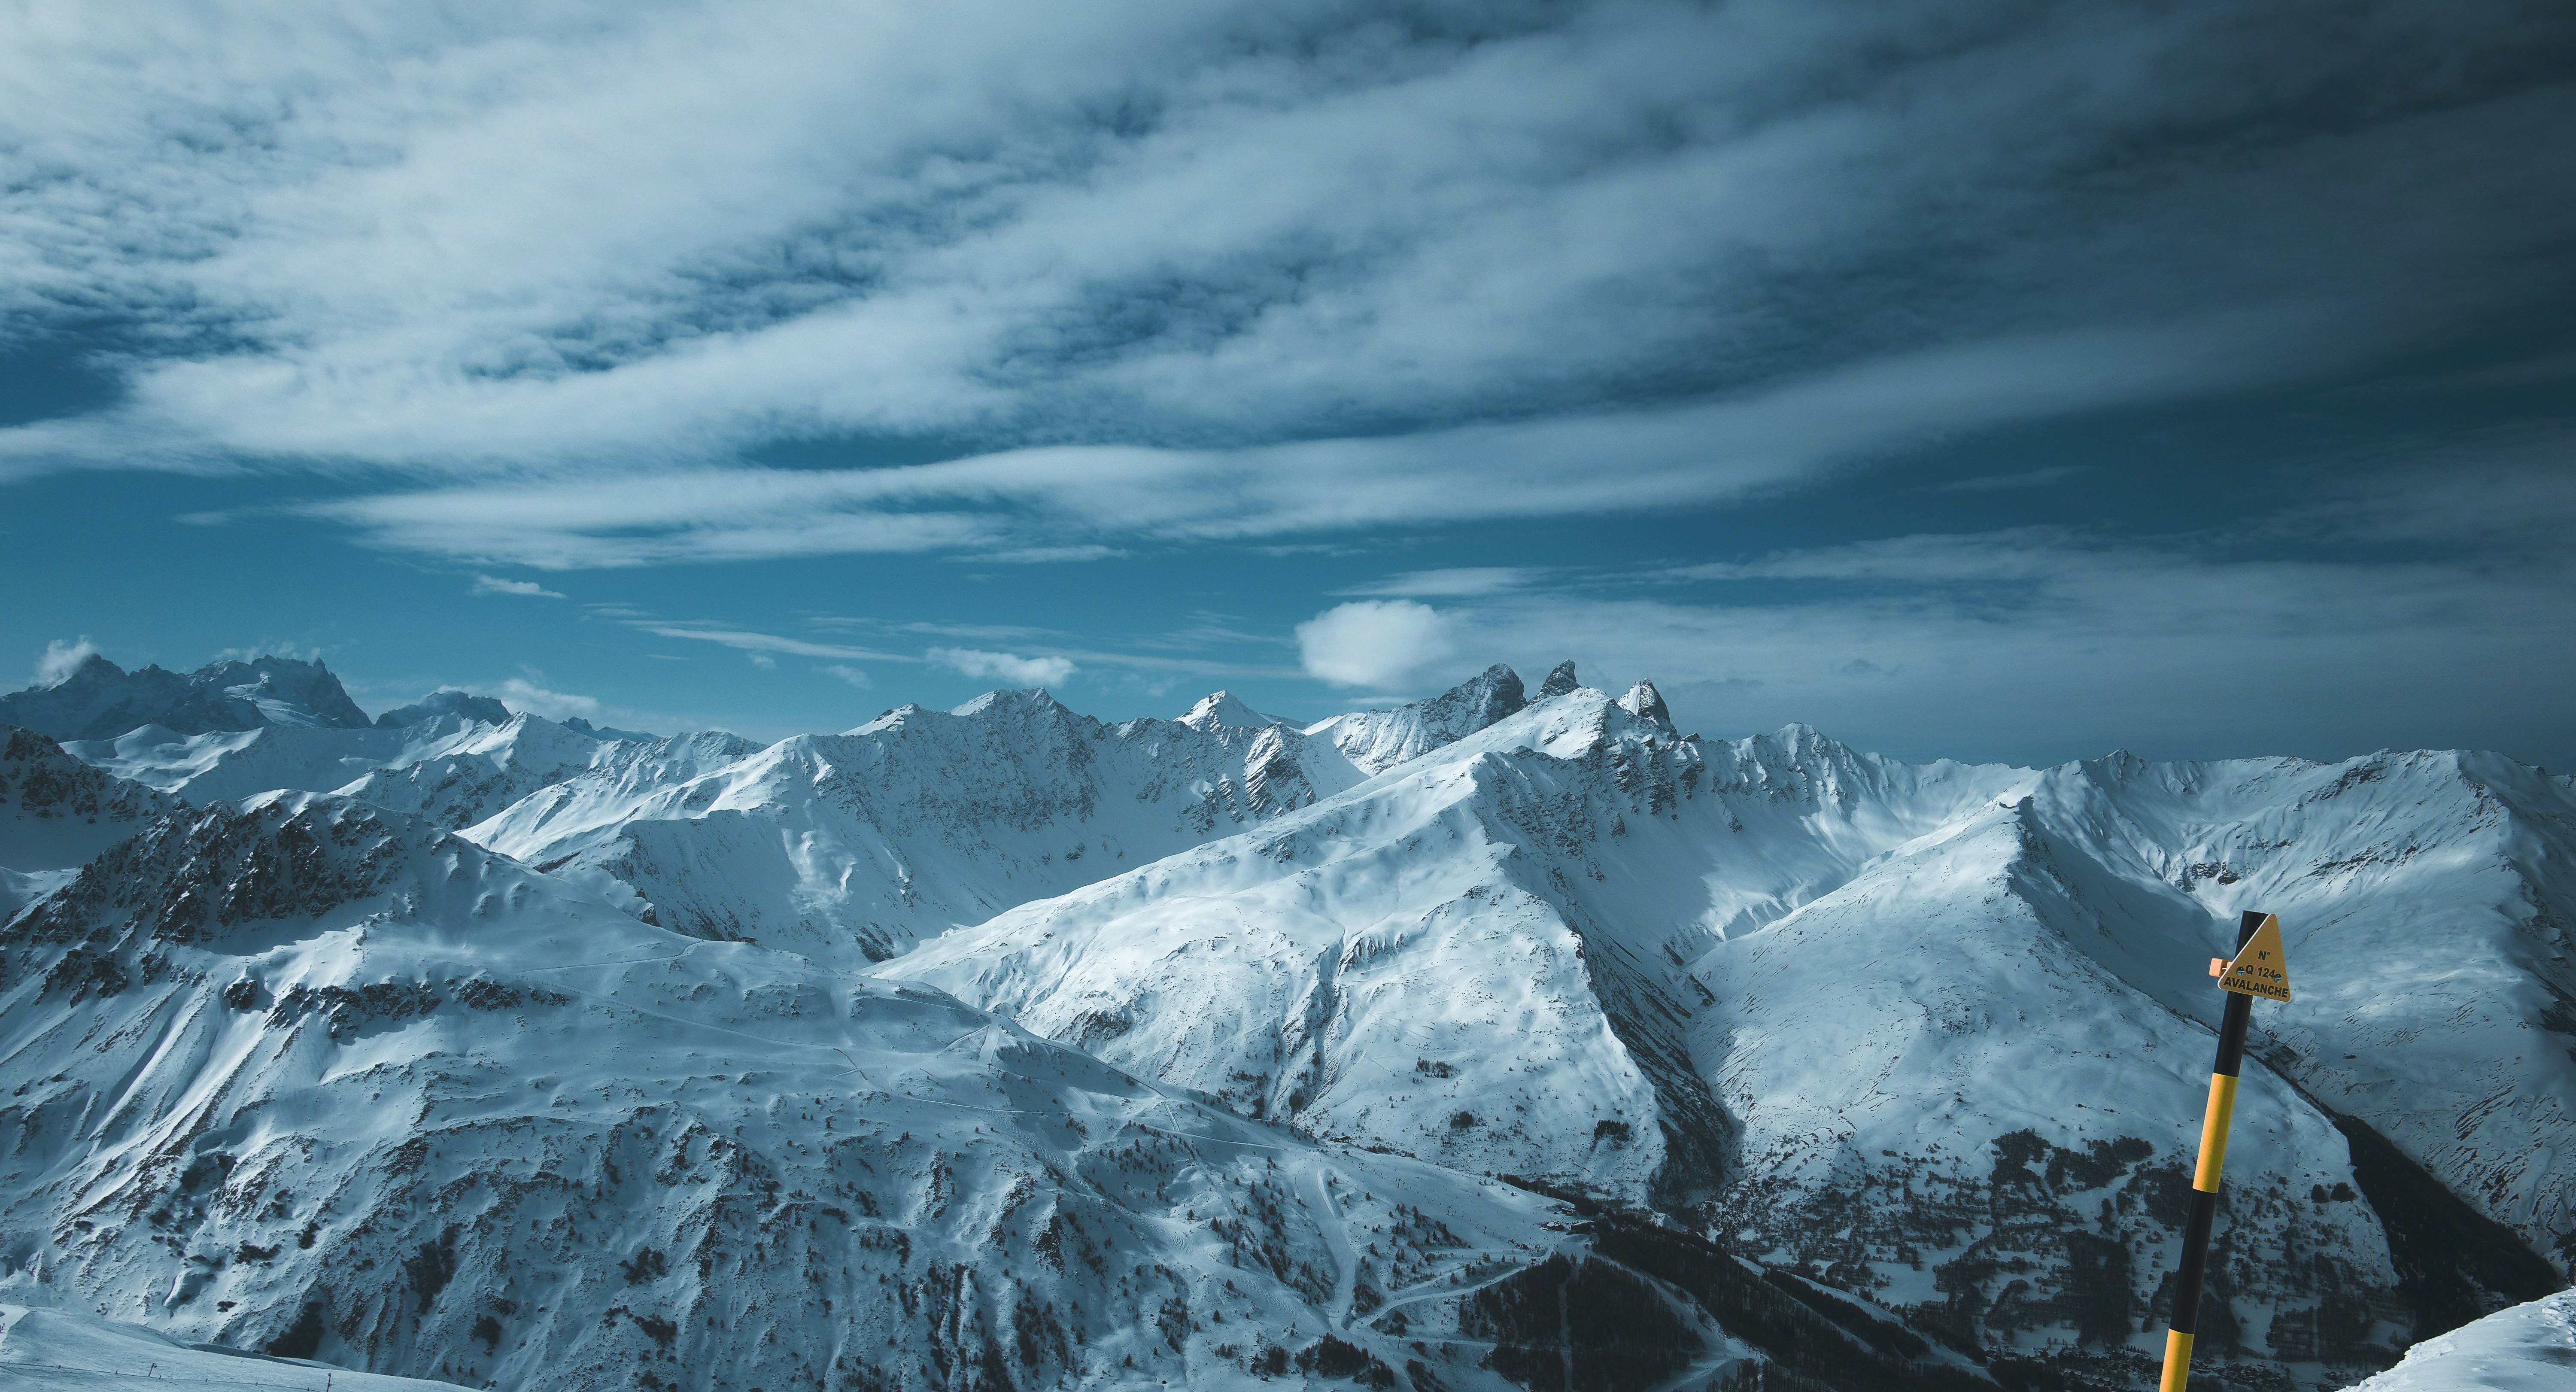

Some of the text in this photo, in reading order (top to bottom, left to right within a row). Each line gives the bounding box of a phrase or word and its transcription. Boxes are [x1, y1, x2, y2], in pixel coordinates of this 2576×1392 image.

[2258, 950, 2270, 960] N°
[2246, 964, 2275, 979] Q 124
[2224, 977, 2289, 998] AVALANCHE
